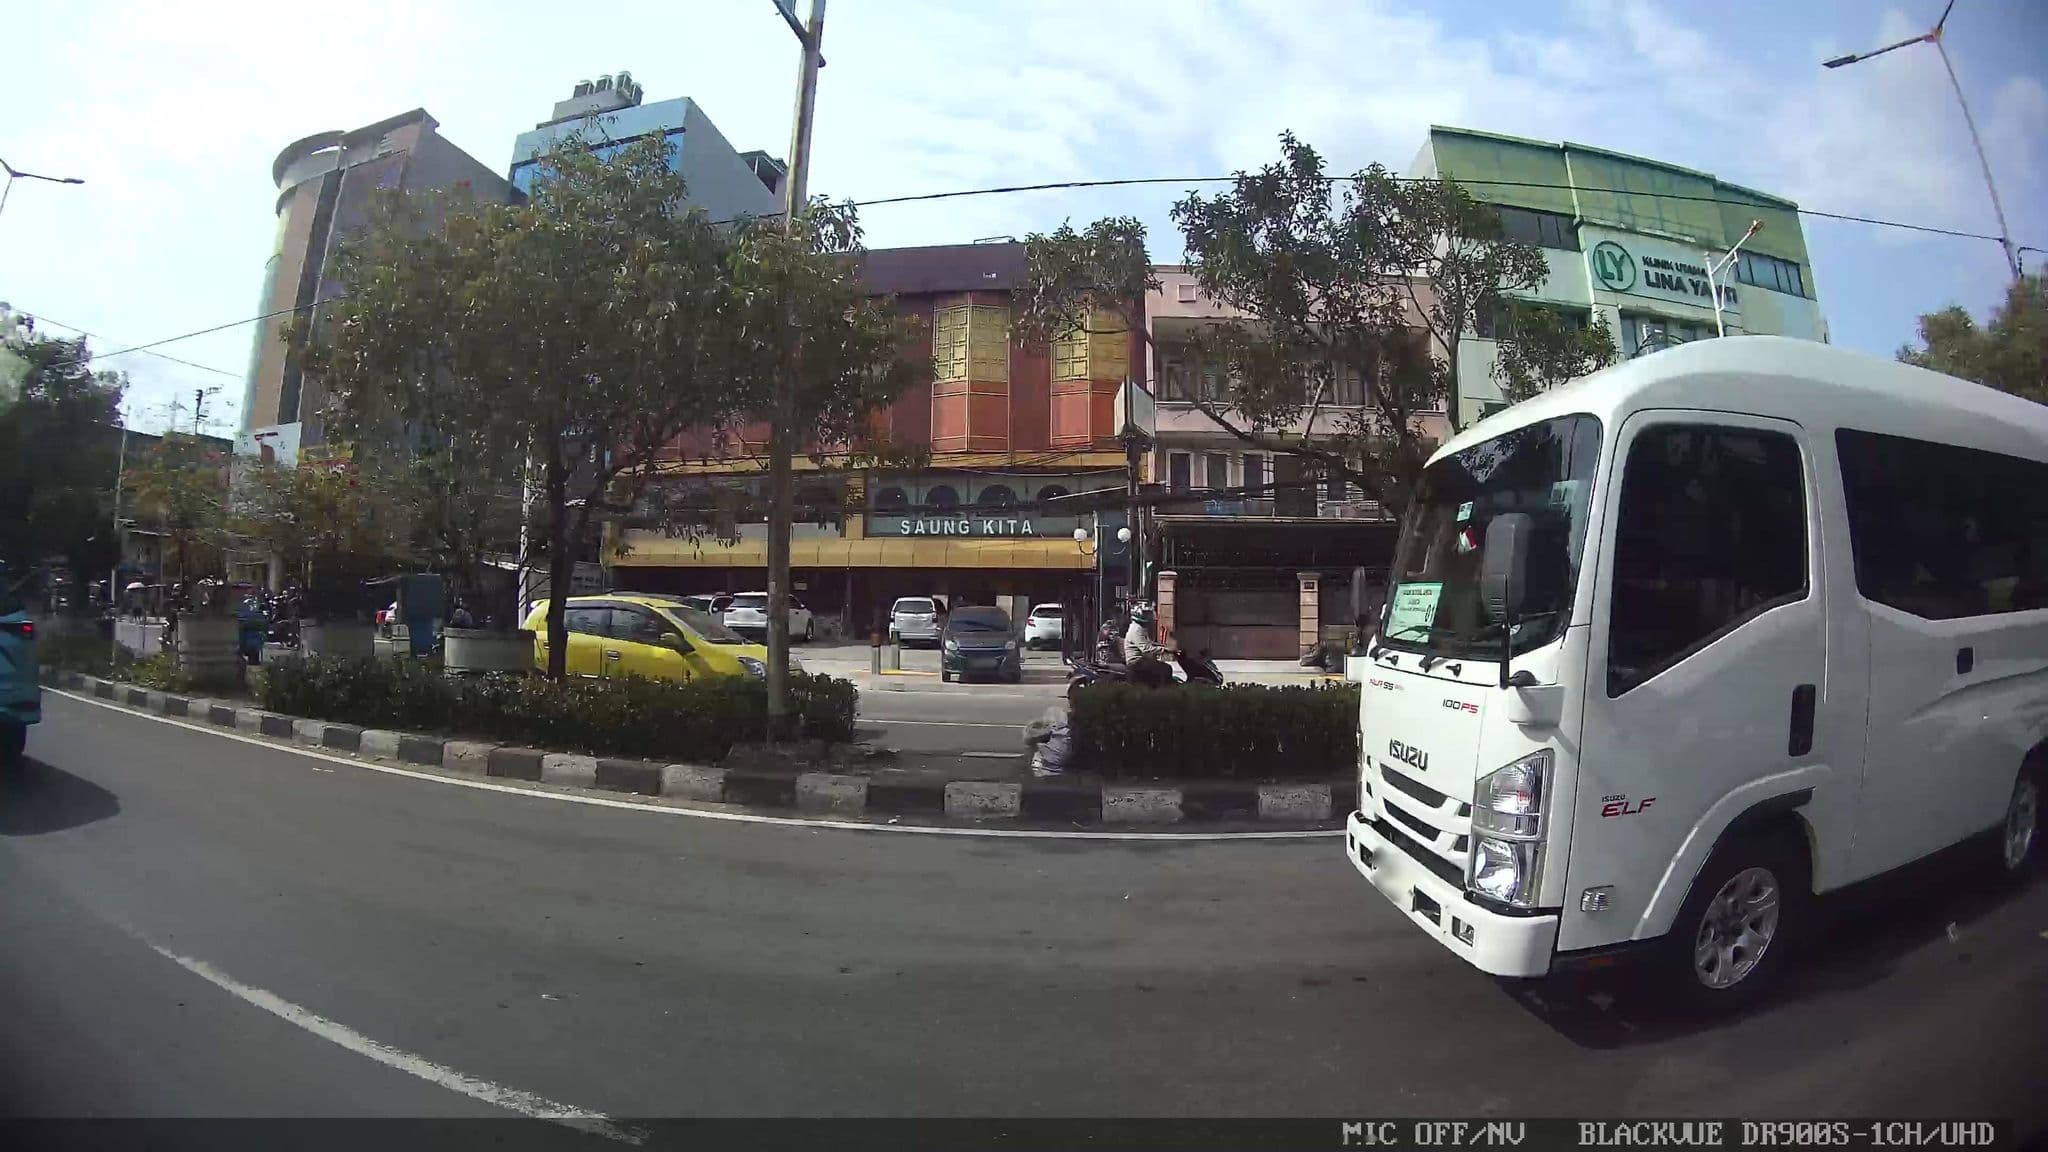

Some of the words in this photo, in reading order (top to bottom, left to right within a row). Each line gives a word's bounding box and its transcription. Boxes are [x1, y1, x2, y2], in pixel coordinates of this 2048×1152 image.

[1598, 250, 1626, 282] LY
[1644, 270, 1688, 293] LINA
[900, 519, 970, 535] SAUNG
[982, 519, 1033, 535] KITA
[1389, 738, 1428, 772] ISUZU
[1601, 794, 1626, 803] ISUZU
[1601, 797, 1657, 818] ELF
